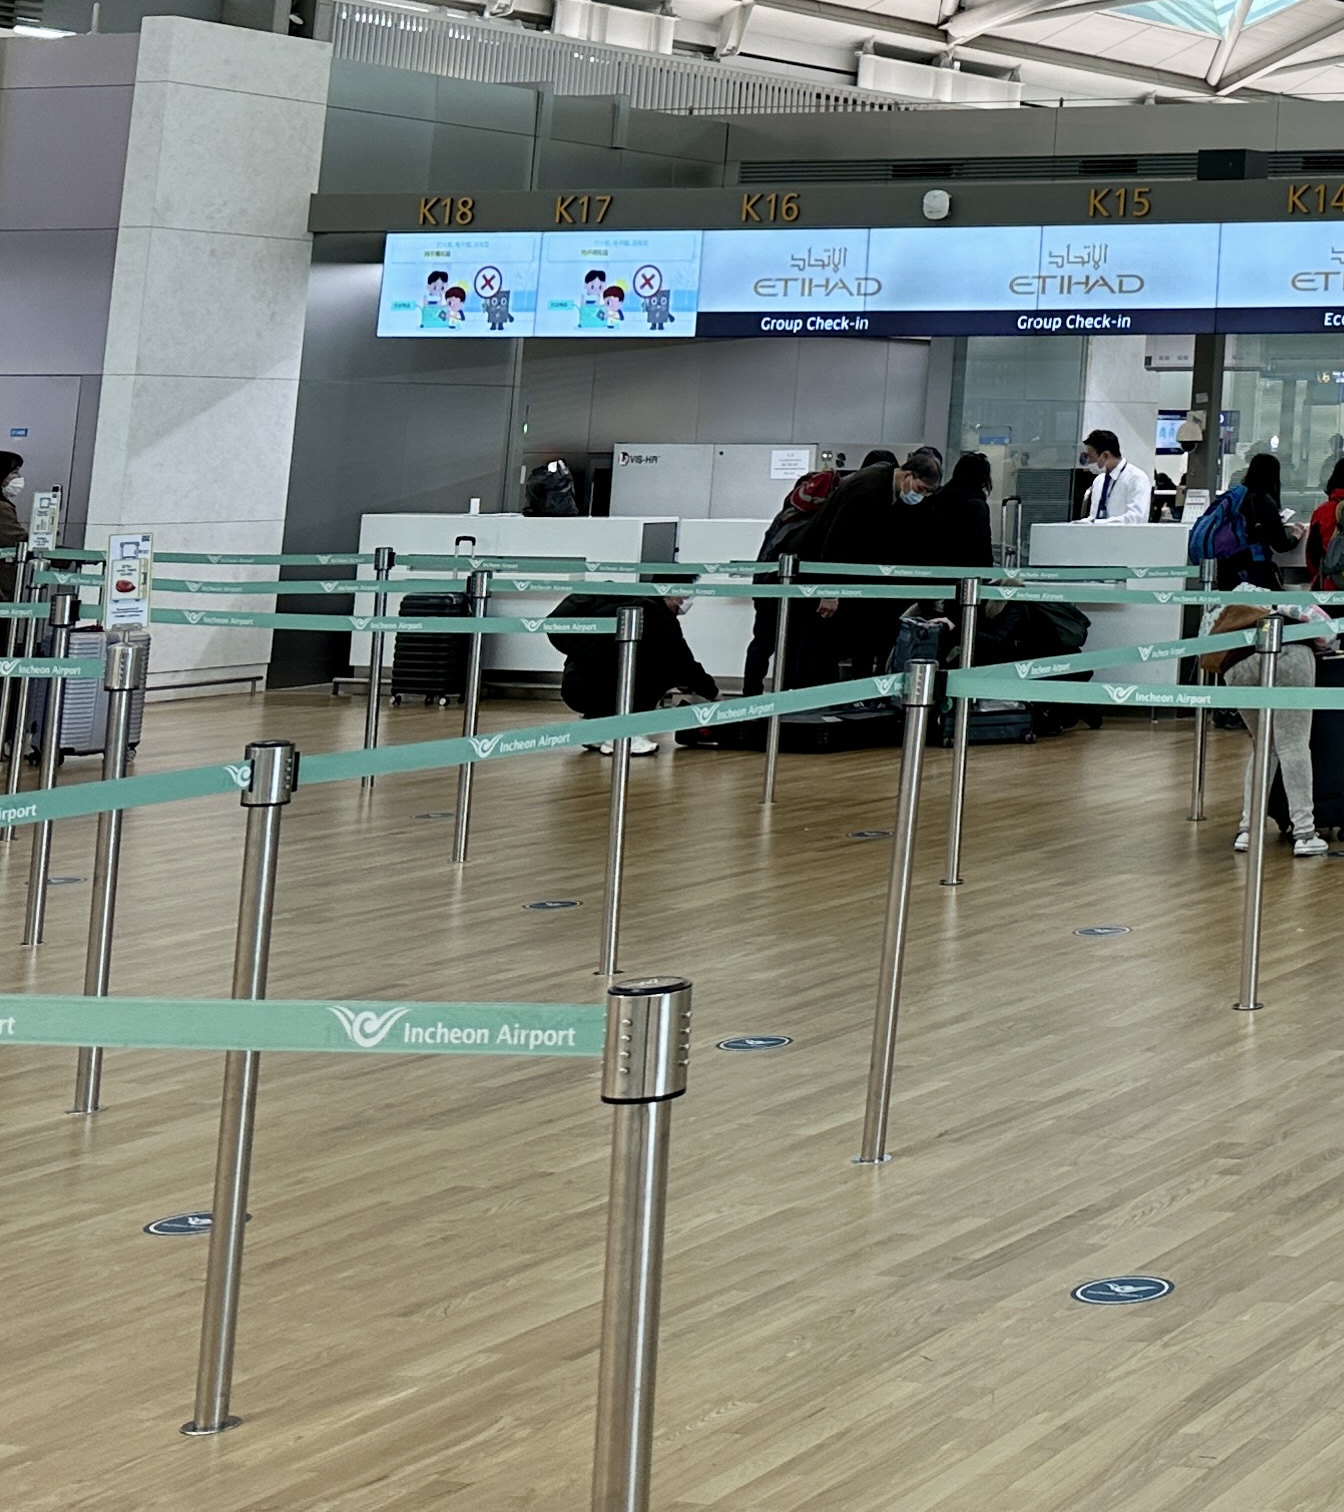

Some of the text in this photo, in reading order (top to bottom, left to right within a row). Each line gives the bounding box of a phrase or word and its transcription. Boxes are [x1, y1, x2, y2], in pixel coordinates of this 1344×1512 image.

[555, 195, 611, 222] K17
[742, 193, 798, 221] K16
[1089, 187, 1150, 216] K15
[419, 197, 472, 225] K18
[754, 276, 882, 298] ETIHAD
[1010, 273, 1144, 295] ETIHAD
[761, 316, 868, 333] Group Check-in
[1018, 314, 1130, 331] Group Check-in
[572, 624, 596, 632] Airport
[52, 666, 80, 676] Airport
[1136, 693, 1211, 706] Incheon Airport
[717, 702, 774, 720] Incheon Airport
[500, 734, 570, 752] Incheon Airport
[0, 805, 36, 822] irport
[404, 1023, 575, 1049] Incheon Airport
